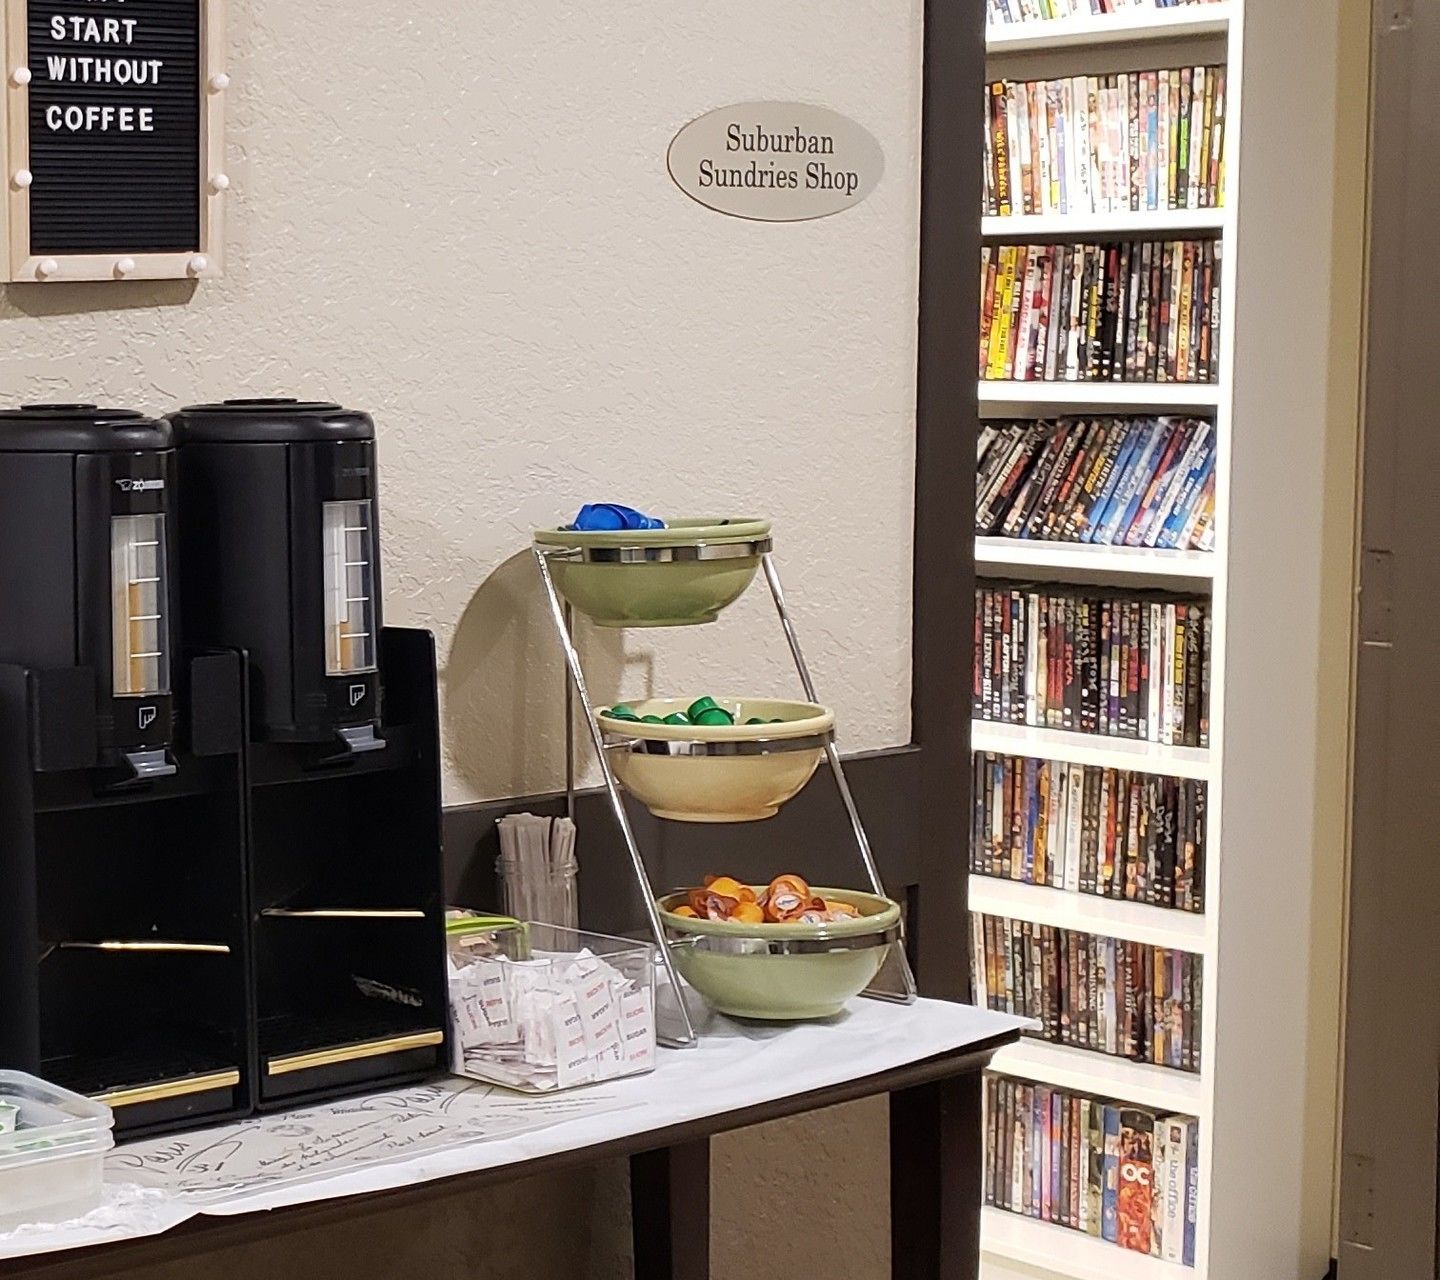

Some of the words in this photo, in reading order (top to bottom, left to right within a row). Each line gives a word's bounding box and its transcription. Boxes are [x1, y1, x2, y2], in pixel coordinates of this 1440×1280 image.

[50, 16, 137, 45] START
[46, 56, 163, 85] WITHOUT
[46, 106, 154, 132] COFFEE
[726, 123, 834, 154] Suburban
[698, 159, 798, 189] Sundries
[805, 161, 859, 196] Shop
